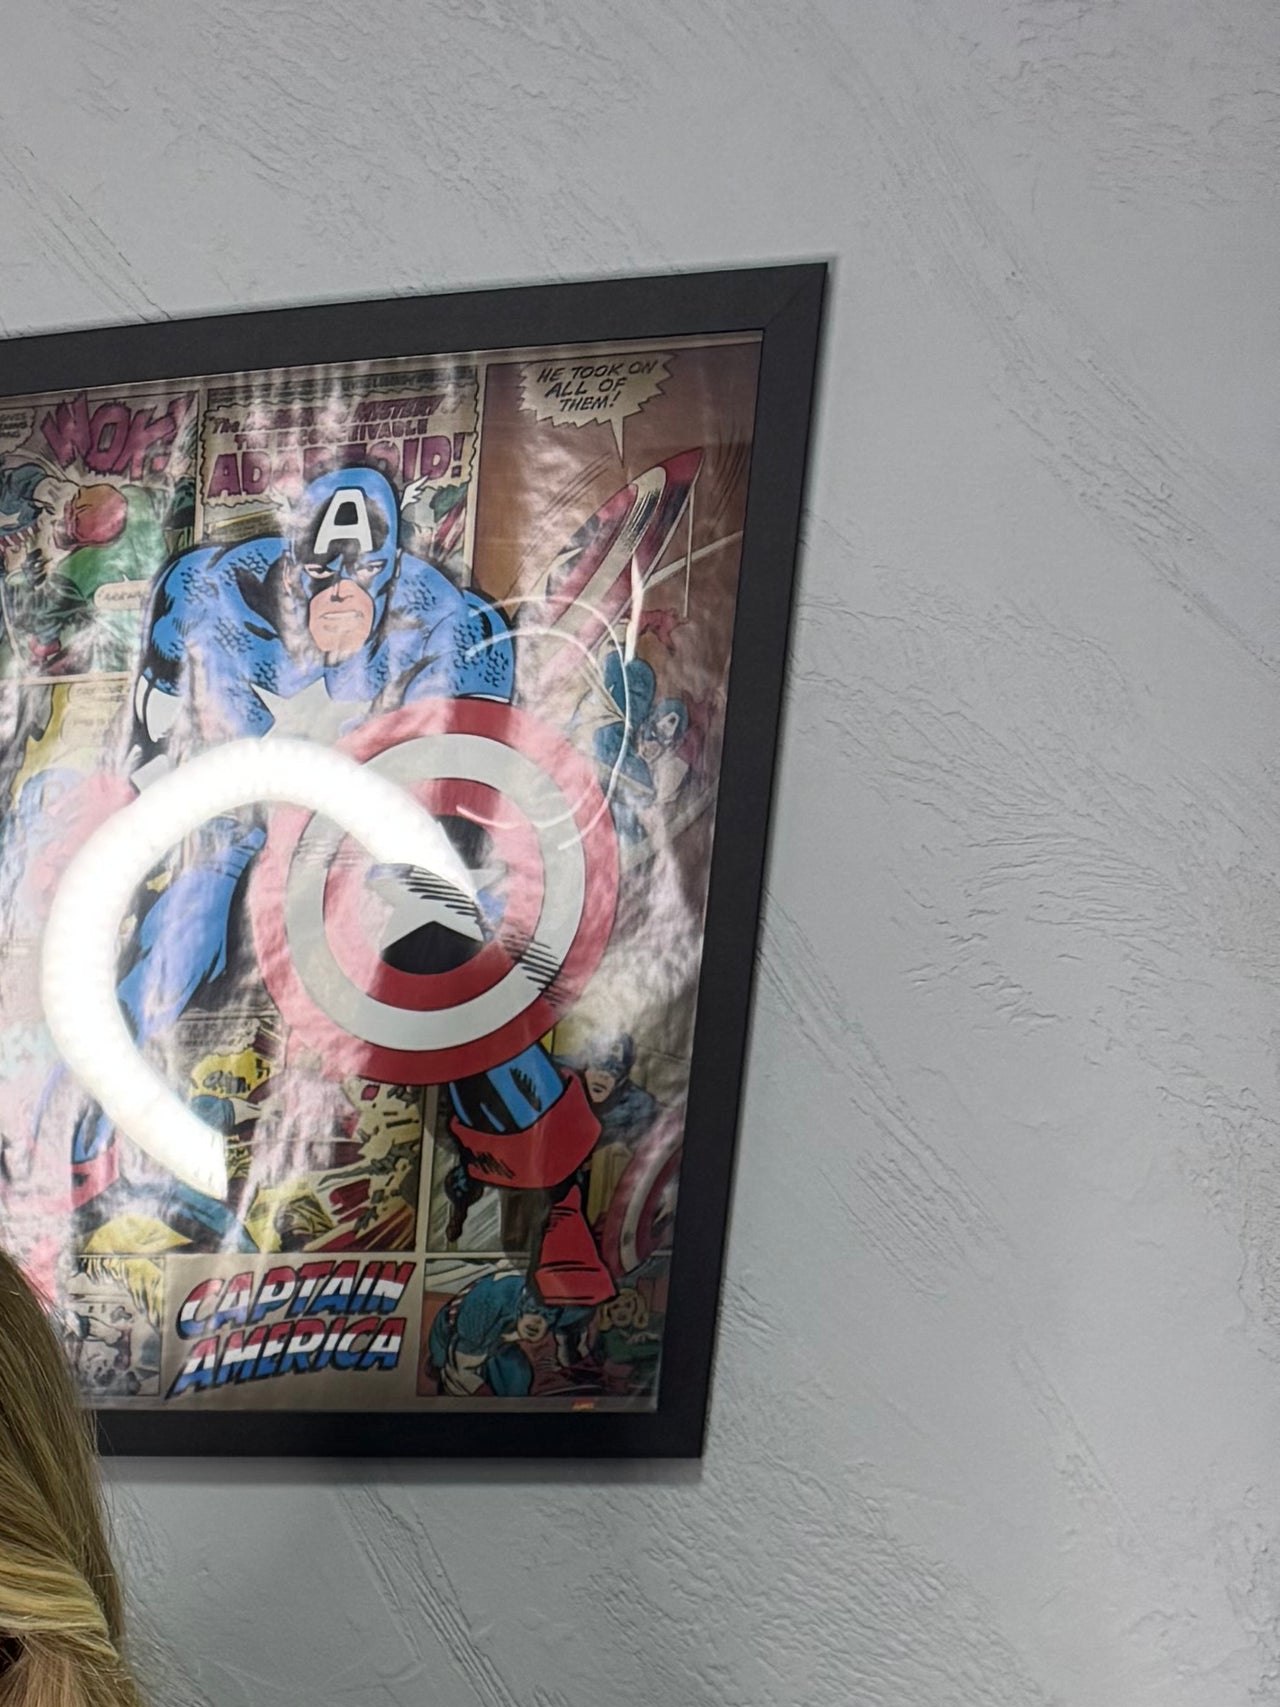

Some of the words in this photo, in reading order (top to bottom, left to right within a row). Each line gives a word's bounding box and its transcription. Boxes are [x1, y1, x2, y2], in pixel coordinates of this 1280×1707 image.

[537, 366, 565, 383] HE
[572, 362, 622, 379] TOOK
[629, 359, 658, 375] ON
[545, 381, 587, 398] ALL
[598, 377, 627, 393] OF
[560, 391, 621, 412] THEM!
[175, 1259, 417, 1341] CAPTAIN
[165, 1316, 408, 1400] AMERICA
